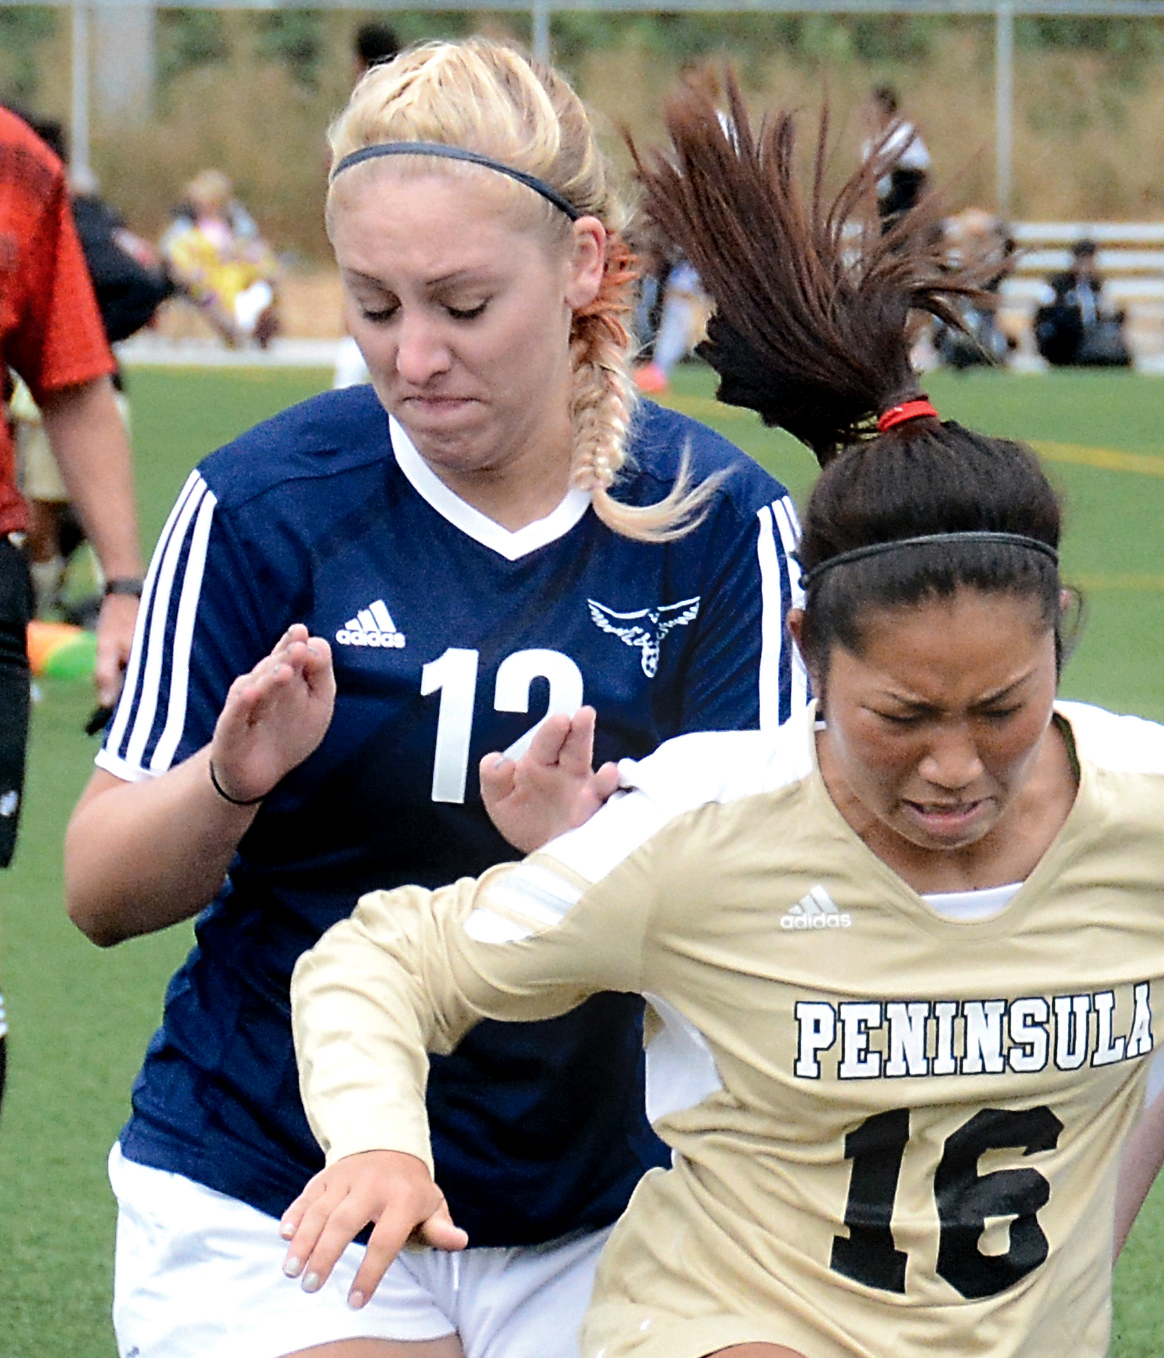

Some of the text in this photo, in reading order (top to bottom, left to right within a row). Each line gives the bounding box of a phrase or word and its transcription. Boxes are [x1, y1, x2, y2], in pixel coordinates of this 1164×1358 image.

[335, 628, 406, 649] adidas
[780, 912, 852, 930] adidas
[793, 980, 1154, 1080] PENINSULA
[829, 1104, 1065, 1300] 16
